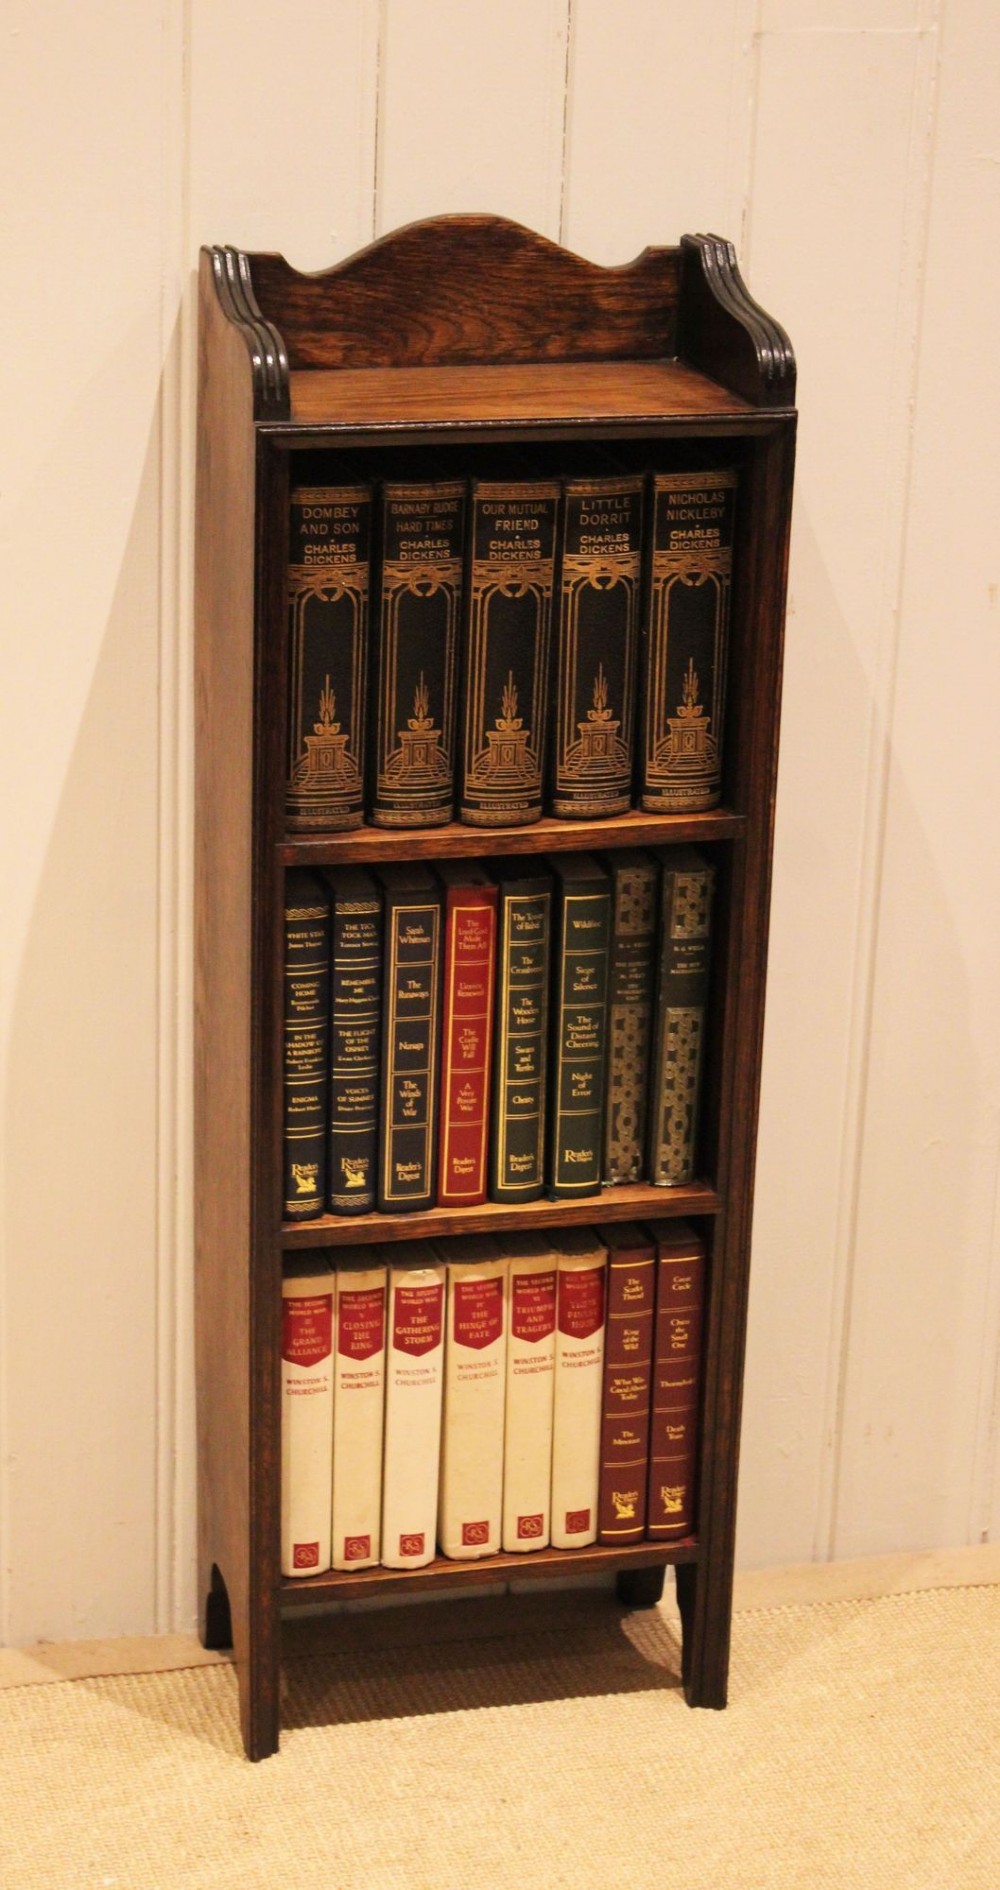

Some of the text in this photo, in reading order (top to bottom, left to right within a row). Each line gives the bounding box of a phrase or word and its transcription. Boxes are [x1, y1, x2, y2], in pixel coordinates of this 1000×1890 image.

[668, 492, 725, 505] NICHOLAS
[391, 503, 430, 515] BARNABY
[482, 503, 548, 515] OUR MUTUAL
[581, 498, 631, 511] LITTLE
[303, 507, 359, 519] DOMBEY
[666, 507, 726, 520] NICKLEBY
[580, 512, 631, 526] DORRIT
[301, 522, 360, 535] AND SON
[396, 519, 454, 532] HARD TIMES
[494, 519, 539, 531] FRIEND
[580, 533, 630, 544] CHARLES
[670, 528, 720, 539] CHARLES
[304, 543, 356, 554] CHARLES
[399, 538, 450, 550] CHARLES
[489, 539, 541, 550] CHARLES
[579, 544, 630, 554] DICKENS
[670, 539, 721, 550] DICKENS
[304, 554, 357, 564] DICKENS
[399, 550, 450, 561] DICKENS
[489, 551, 541, 561] DICKENS
[480, 800, 529, 810] ILLUSTRATED
[511, 913, 525, 921] The
[407, 980, 421, 989] The
[576, 1016, 592, 1024] The
[463, 1028, 476, 1036] The
[403, 1081, 418, 1089] The
[402, 1108, 417, 1116] War
[410, 1316, 429, 1324] THE
[526, 1315, 544, 1323] AND
